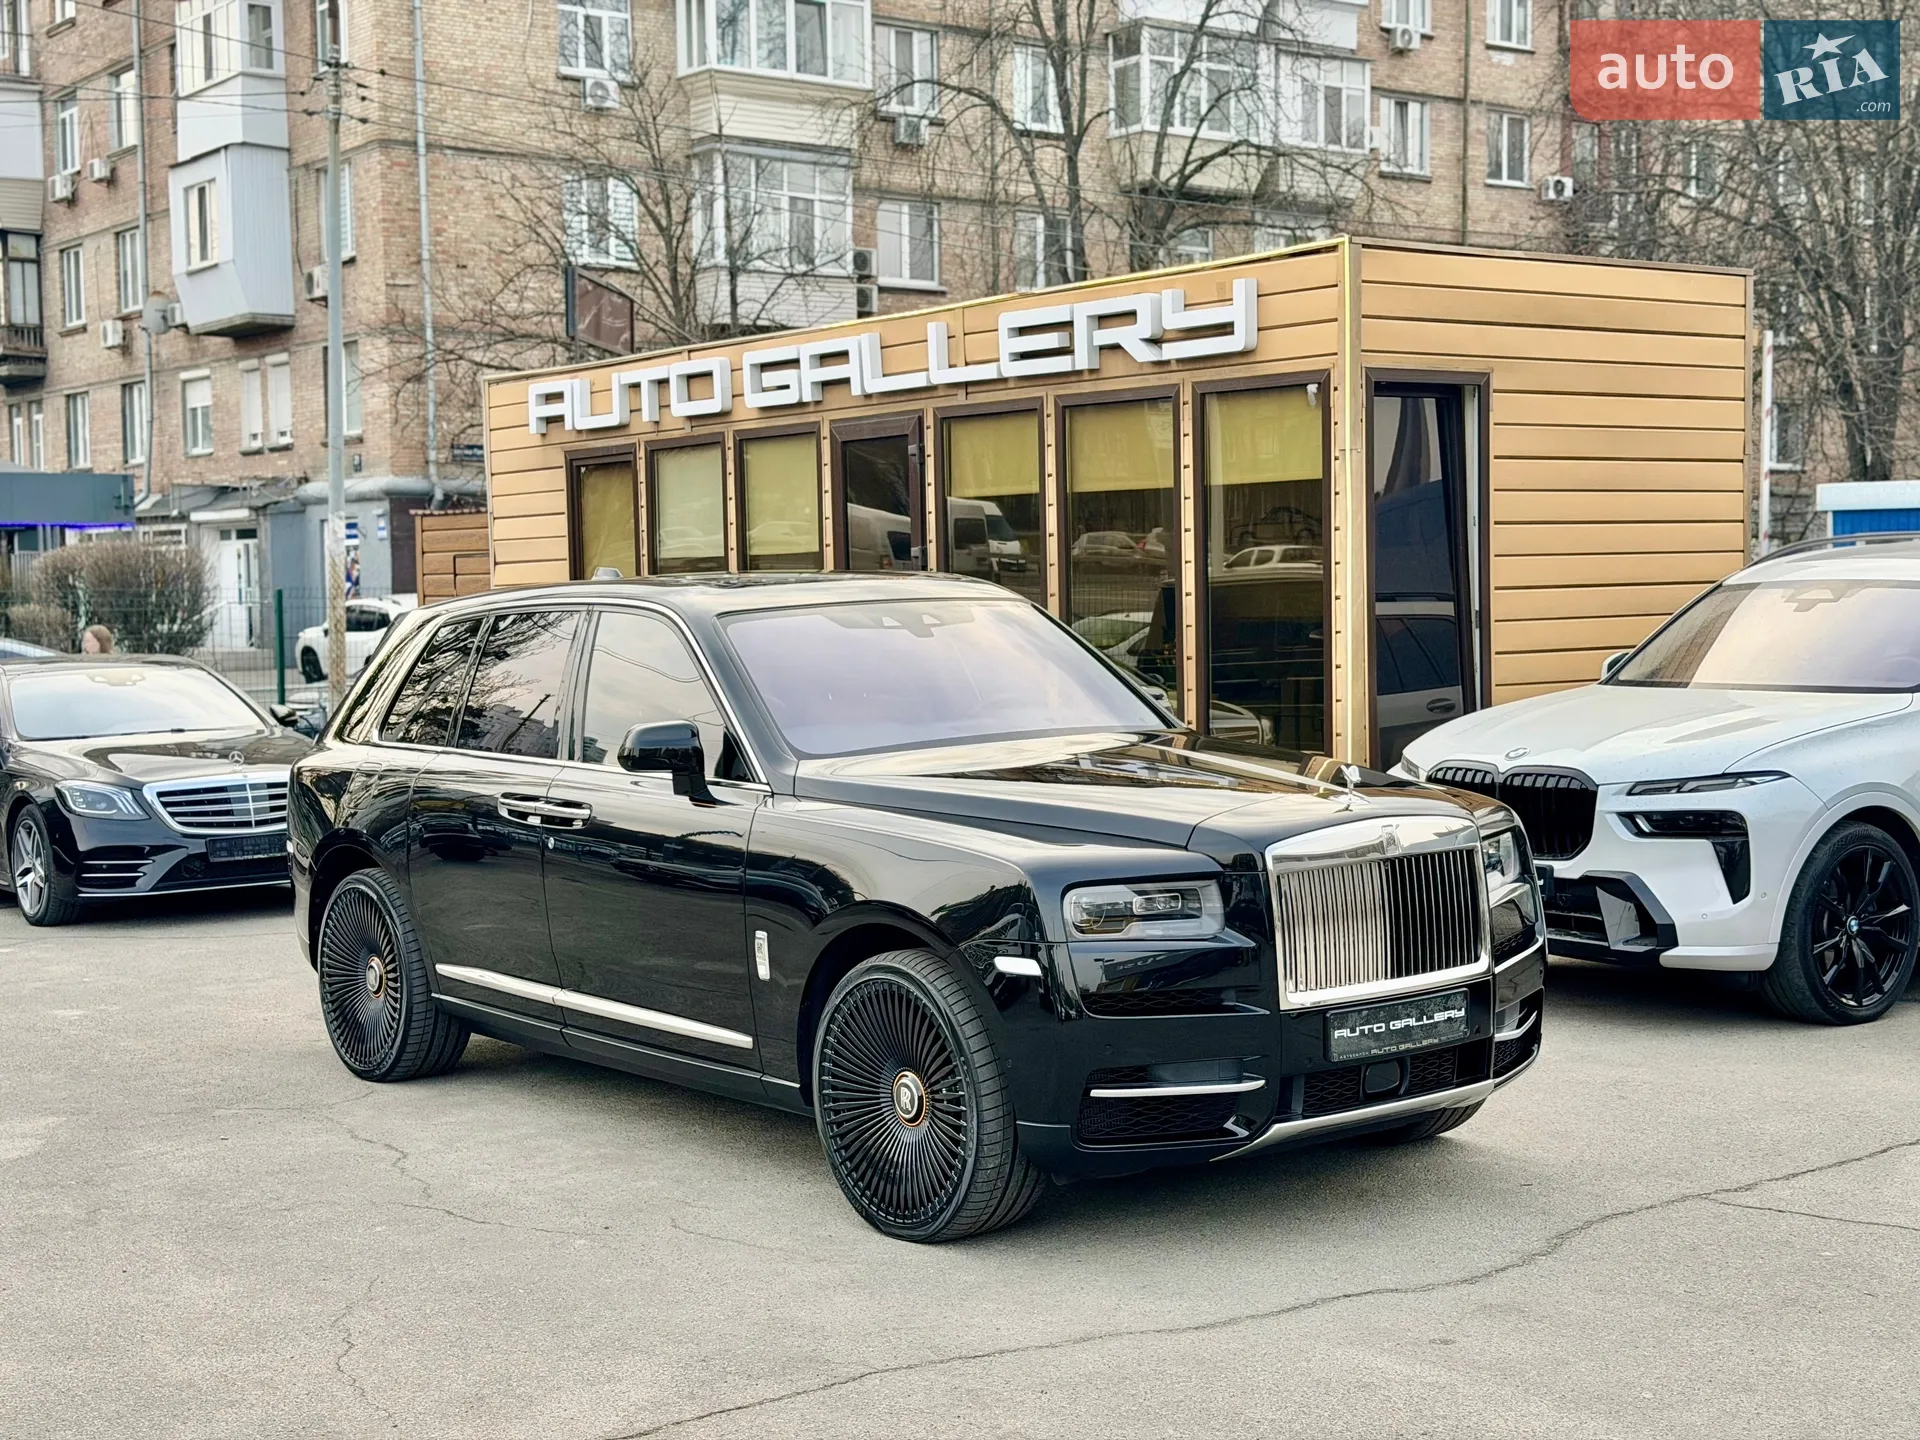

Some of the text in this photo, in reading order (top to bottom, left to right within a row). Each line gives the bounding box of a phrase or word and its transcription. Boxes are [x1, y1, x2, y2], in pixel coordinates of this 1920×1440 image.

[529, 277, 1259, 435] AUTO GALLERY
[1334, 1007, 1466, 1039] AUTO GALLERY
[1370, 1045, 1397, 1055] AUTO
